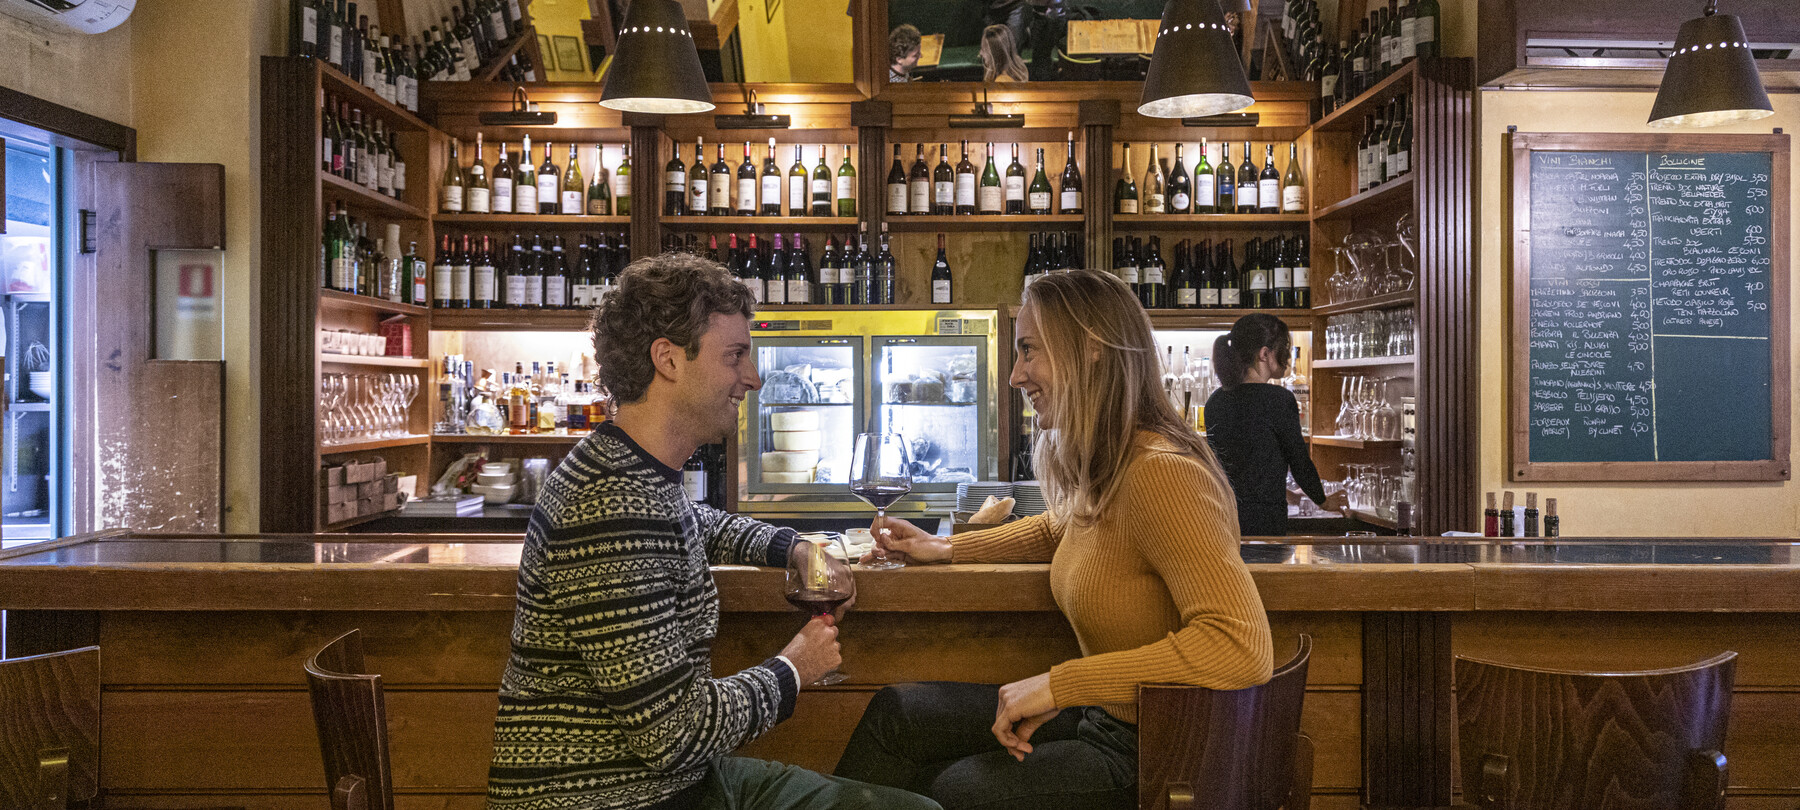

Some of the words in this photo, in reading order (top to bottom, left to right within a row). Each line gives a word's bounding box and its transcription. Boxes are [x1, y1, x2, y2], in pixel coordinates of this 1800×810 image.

[1539, 155, 1561, 165] VINI
[1568, 155, 1612, 166] BIANCHI
[1659, 155, 1705, 166] BOLLICINE
[1749, 173, 1768, 185] 3,50
[1548, 279, 1569, 287] VINI
[1628, 341, 1649, 354] 5,00
[1565, 351, 1577, 359] LE
[1626, 361, 1646, 373] 4,50
[1625, 393, 1649, 406] 4,50
[1629, 405, 1650, 419] 5,00
[1588, 427, 1598, 438] BY
